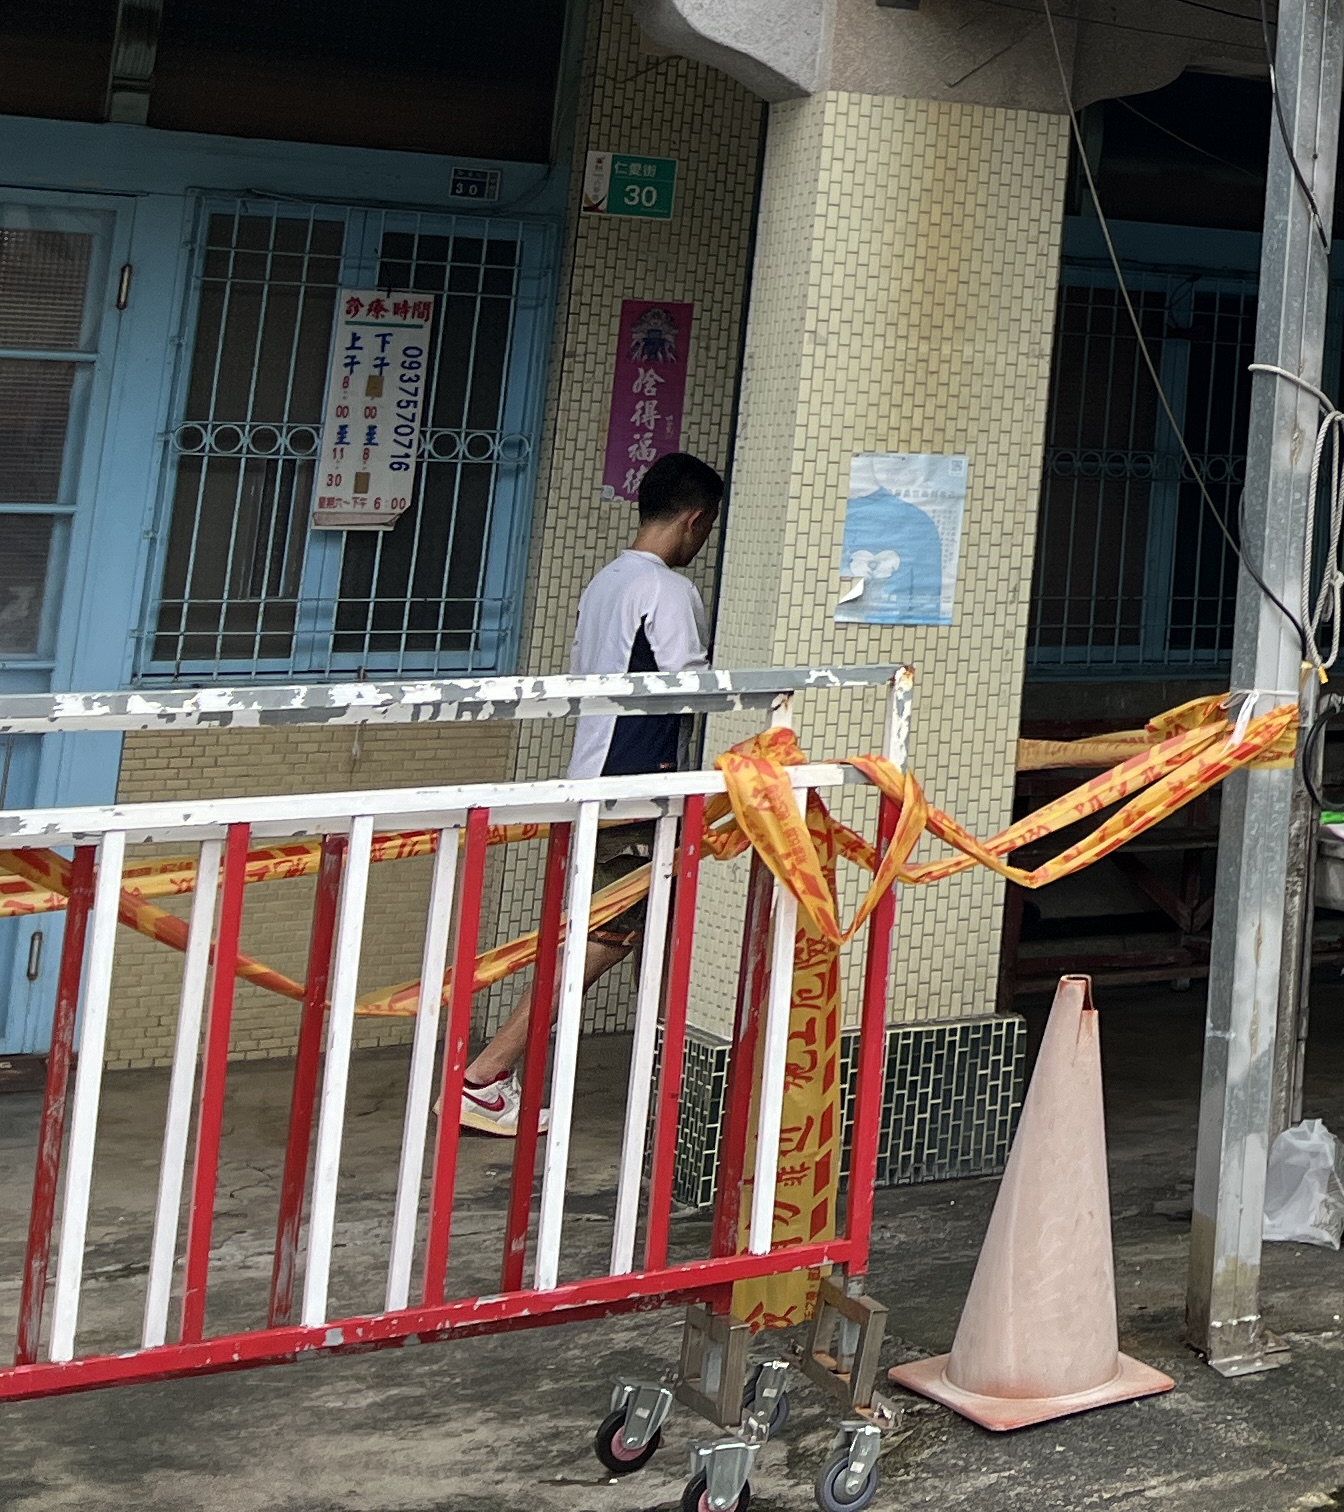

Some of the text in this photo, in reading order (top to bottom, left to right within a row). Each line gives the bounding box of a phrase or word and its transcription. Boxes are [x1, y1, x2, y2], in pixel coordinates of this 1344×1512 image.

[614, 161, 657, 177] 仁愛街
[624, 184, 657, 207] 30
[345, 296, 434, 323] 診療時間
[389, 346, 424, 472] 0937570716
